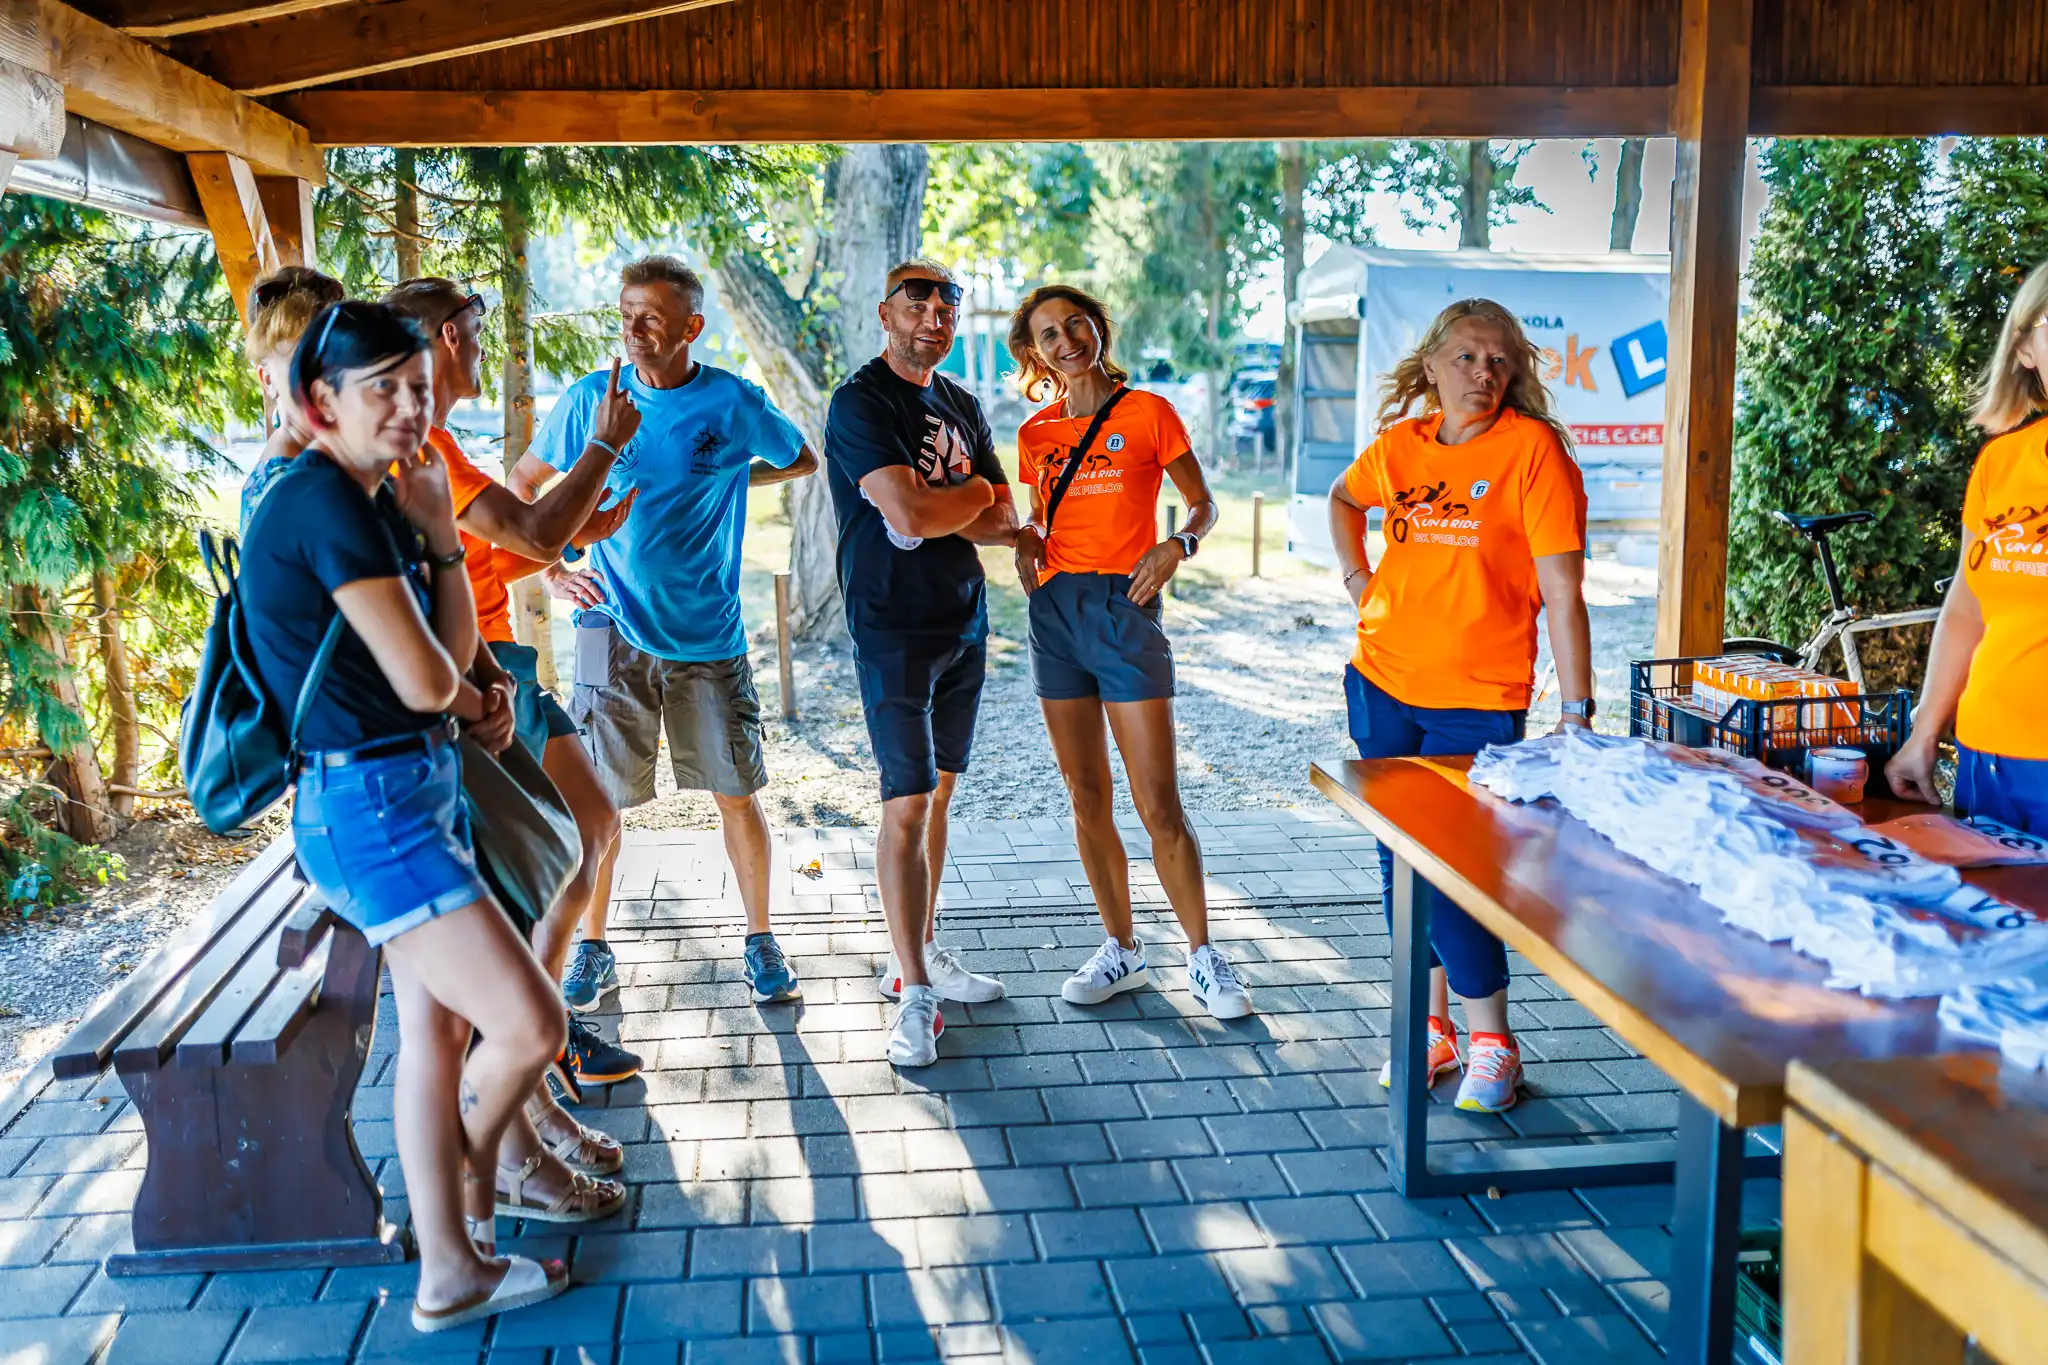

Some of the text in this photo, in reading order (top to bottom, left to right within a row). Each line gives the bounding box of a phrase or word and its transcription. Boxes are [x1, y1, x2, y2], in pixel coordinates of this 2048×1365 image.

[1098, 469, 1124, 479] RIDE
[1082, 482, 1124, 496] PRELOG
[1450, 519, 1482, 530] RIDE
[1430, 534, 1480, 547] PRELOG
